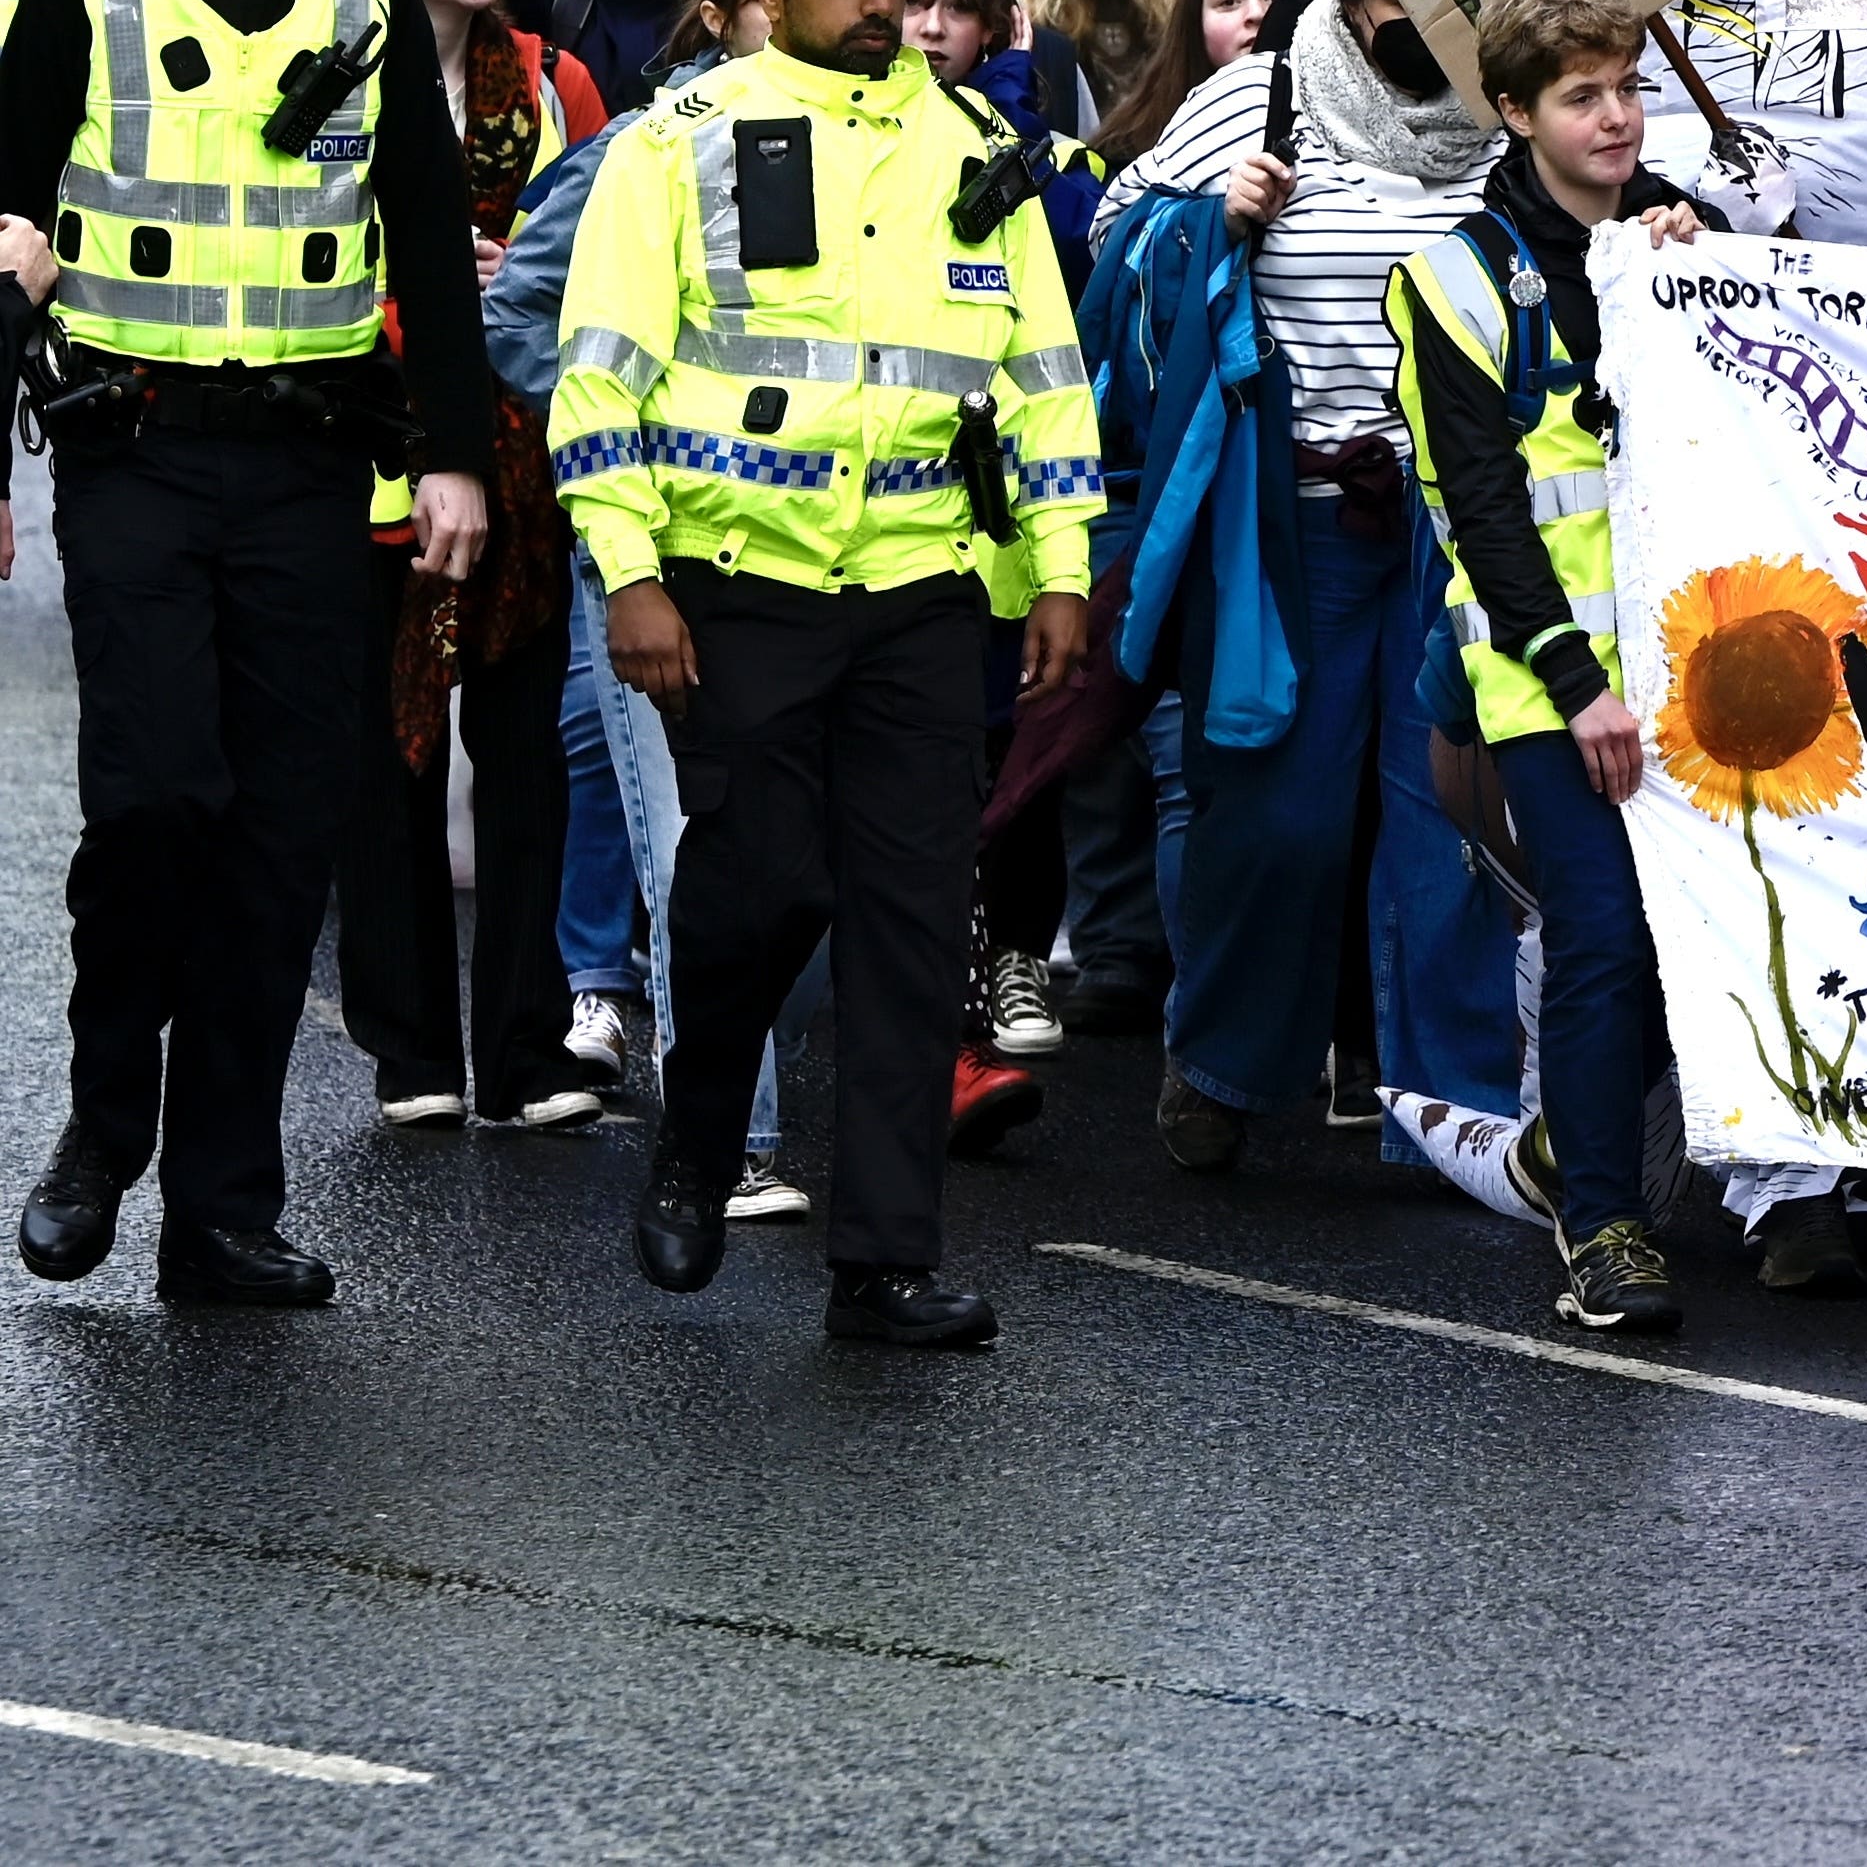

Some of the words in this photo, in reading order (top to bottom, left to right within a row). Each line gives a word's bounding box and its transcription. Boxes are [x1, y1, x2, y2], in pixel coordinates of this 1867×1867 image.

[310, 139, 366, 158] POLICE
[951, 267, 1008, 287] POLICE
[1769, 247, 1814, 275] THE
[1652, 276, 1779, 313] UPROOT
[1773, 324, 1861, 383] VICTORY
[1696, 335, 1778, 403] VICTORY
[1780, 396, 1809, 434] TO
[1806, 443, 1840, 483] THE
